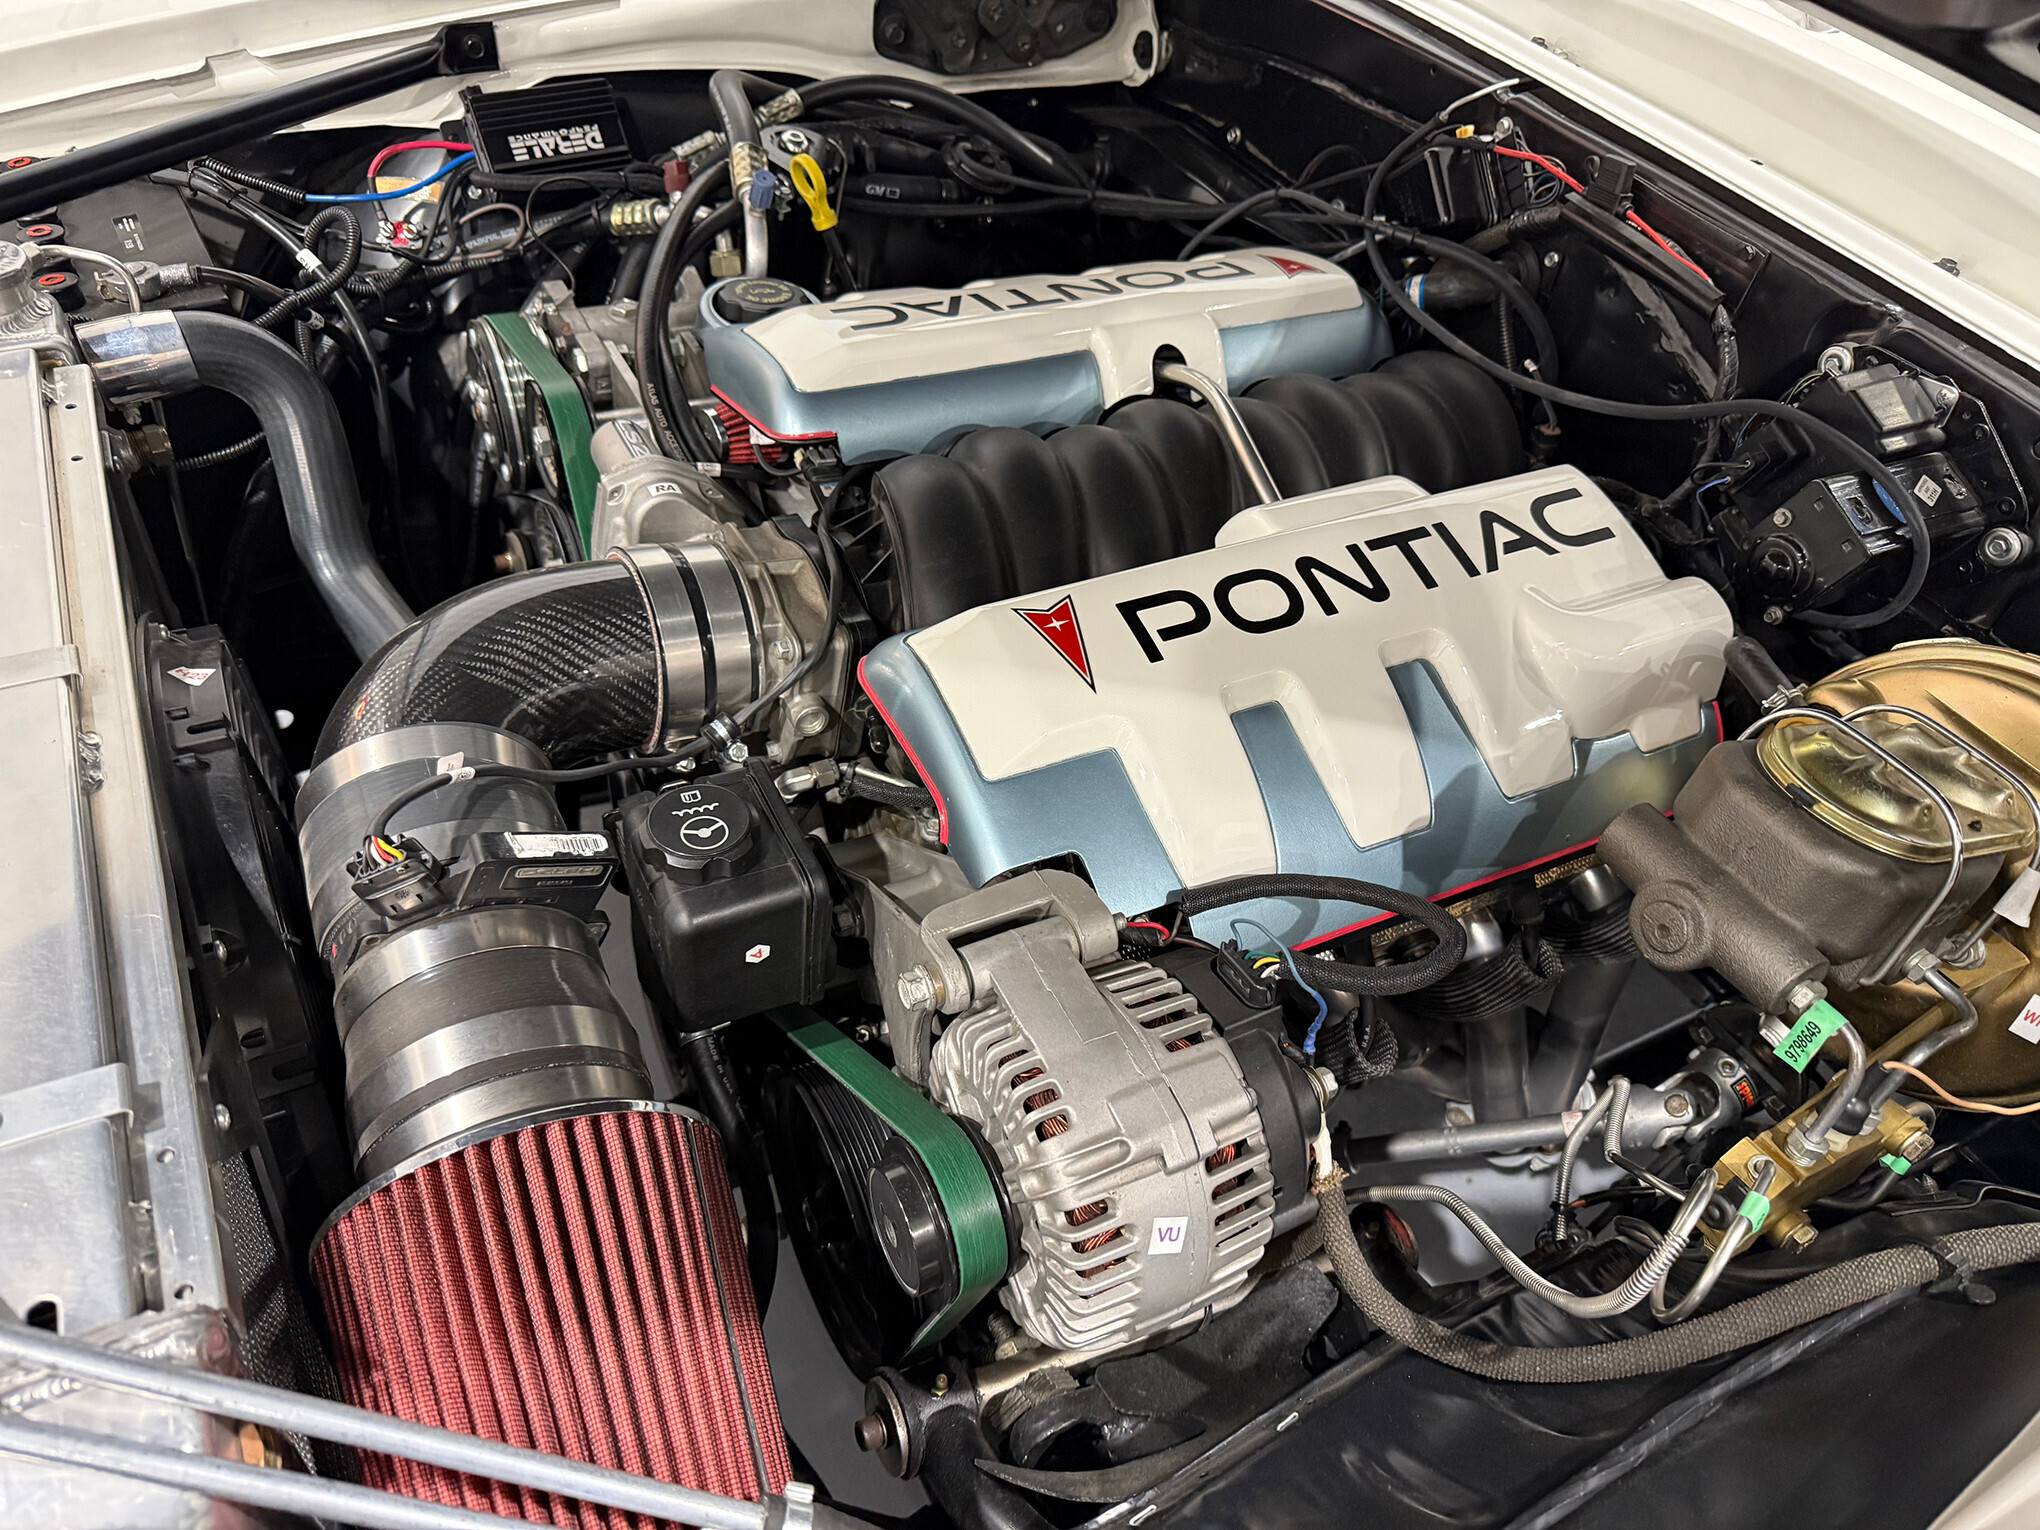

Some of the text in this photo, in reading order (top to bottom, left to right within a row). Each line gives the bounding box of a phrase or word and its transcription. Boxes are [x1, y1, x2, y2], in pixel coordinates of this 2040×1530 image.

[510, 130, 606, 162] DERALE
[828, 261, 1256, 332] PONTIAC
[654, 407, 668, 428] AUTO
[655, 483, 677, 493] RA
[1115, 487, 1617, 664] PONTIAC
[1784, 1020, 1822, 1063] 9798649
[1158, 1226, 1181, 1242] VU
